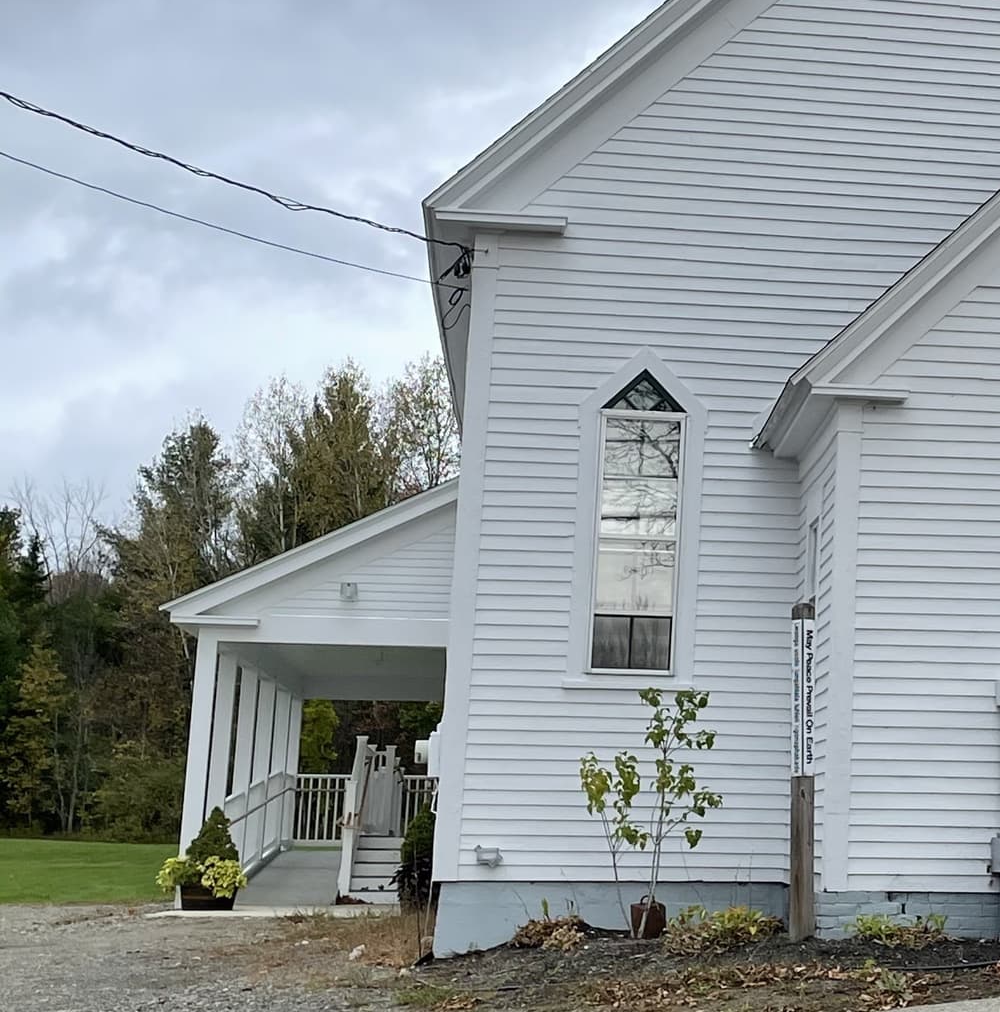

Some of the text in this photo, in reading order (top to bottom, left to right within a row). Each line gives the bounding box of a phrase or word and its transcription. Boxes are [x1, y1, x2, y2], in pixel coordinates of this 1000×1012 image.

[805, 630, 814, 765] May Peace Prevail On Earth
